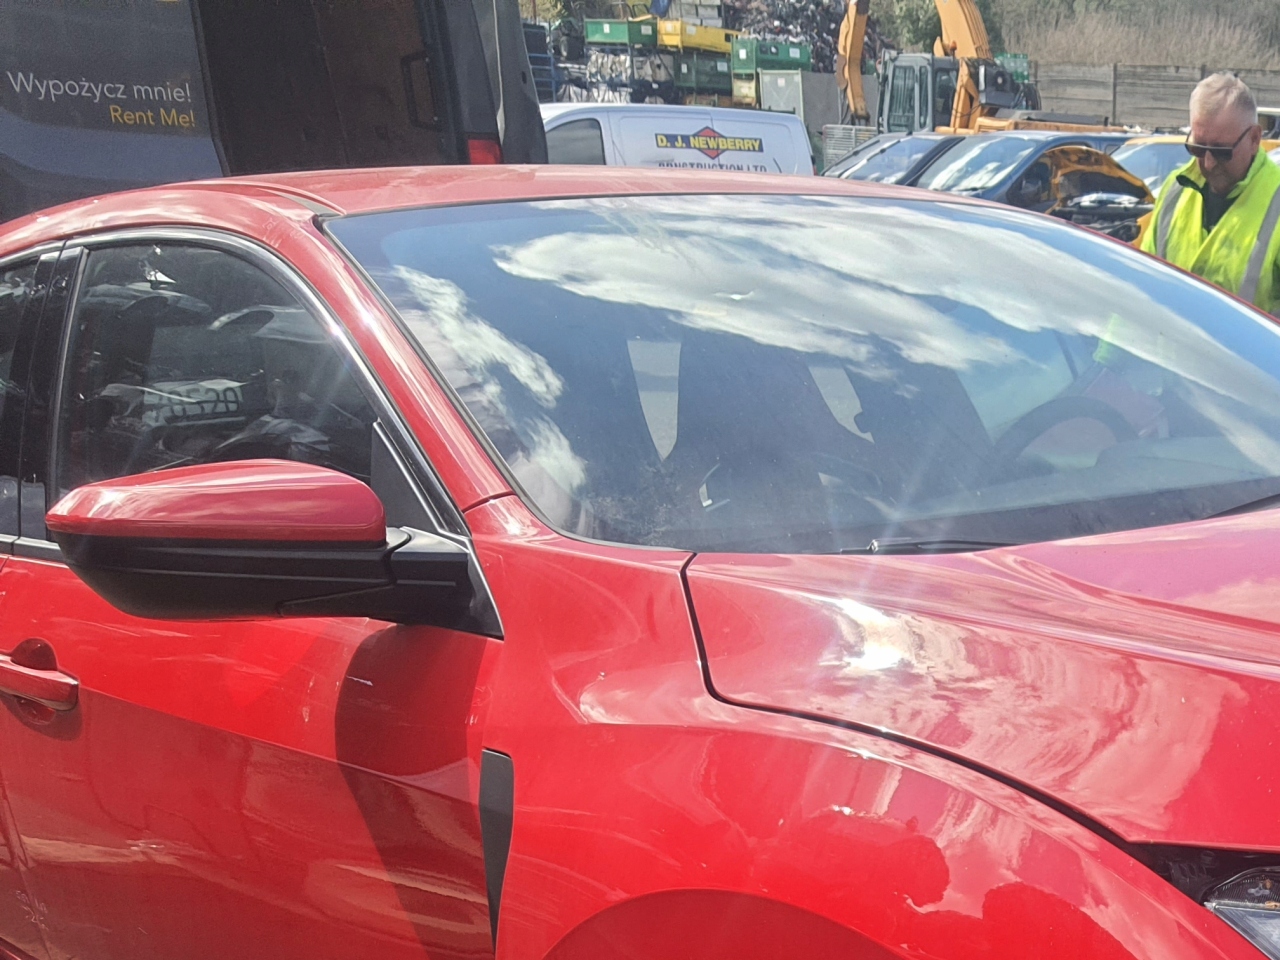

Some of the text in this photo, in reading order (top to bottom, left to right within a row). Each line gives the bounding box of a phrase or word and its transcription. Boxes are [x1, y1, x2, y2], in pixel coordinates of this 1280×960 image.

[6, 71, 192, 102] Wypożycz mnie!
[109, 104, 196, 127] Rent Me!
[657, 135, 760, 151] D. J. NEWBERRY
